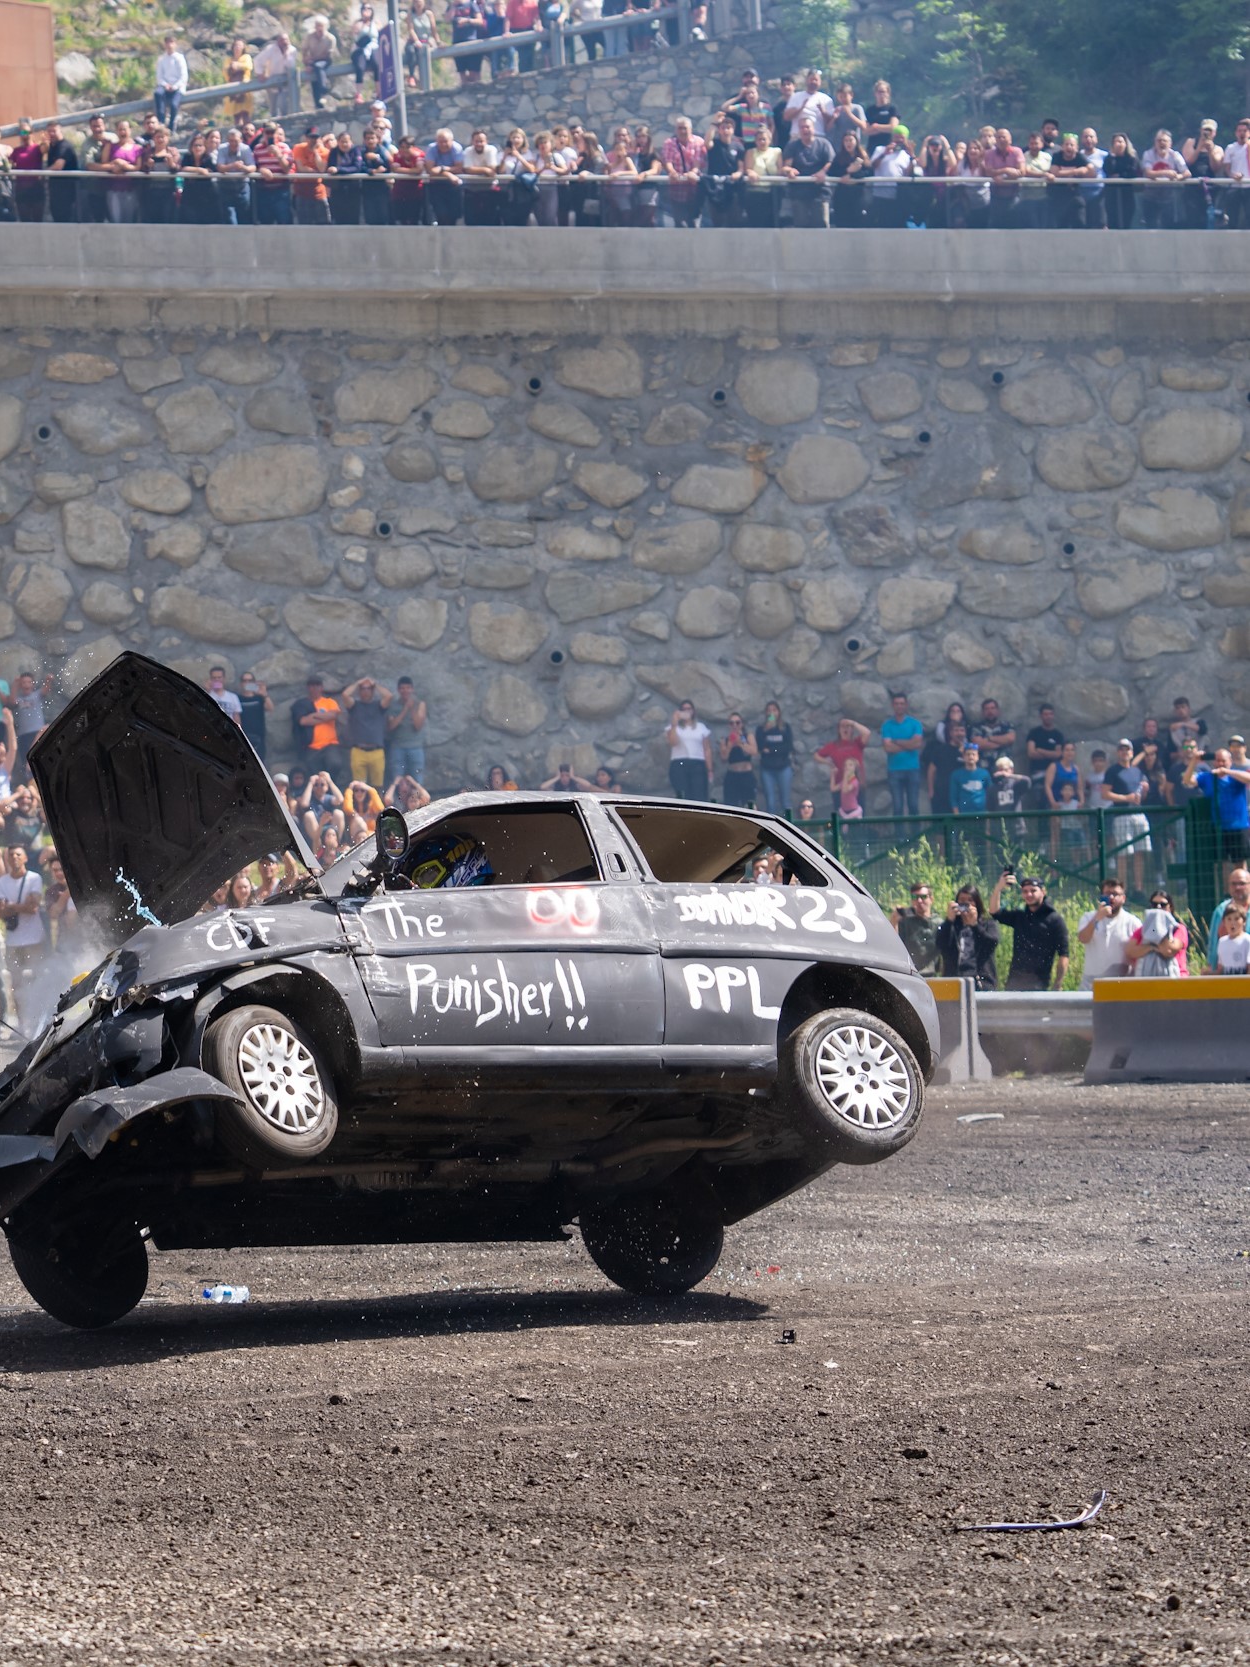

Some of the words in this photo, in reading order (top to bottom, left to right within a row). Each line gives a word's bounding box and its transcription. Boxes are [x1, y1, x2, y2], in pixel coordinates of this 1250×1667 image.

[361, 896, 447, 941] The
[796, 889, 867, 943] 23
[406, 958, 590, 1031] Punisher!!
[683, 963, 782, 1021] PPL
